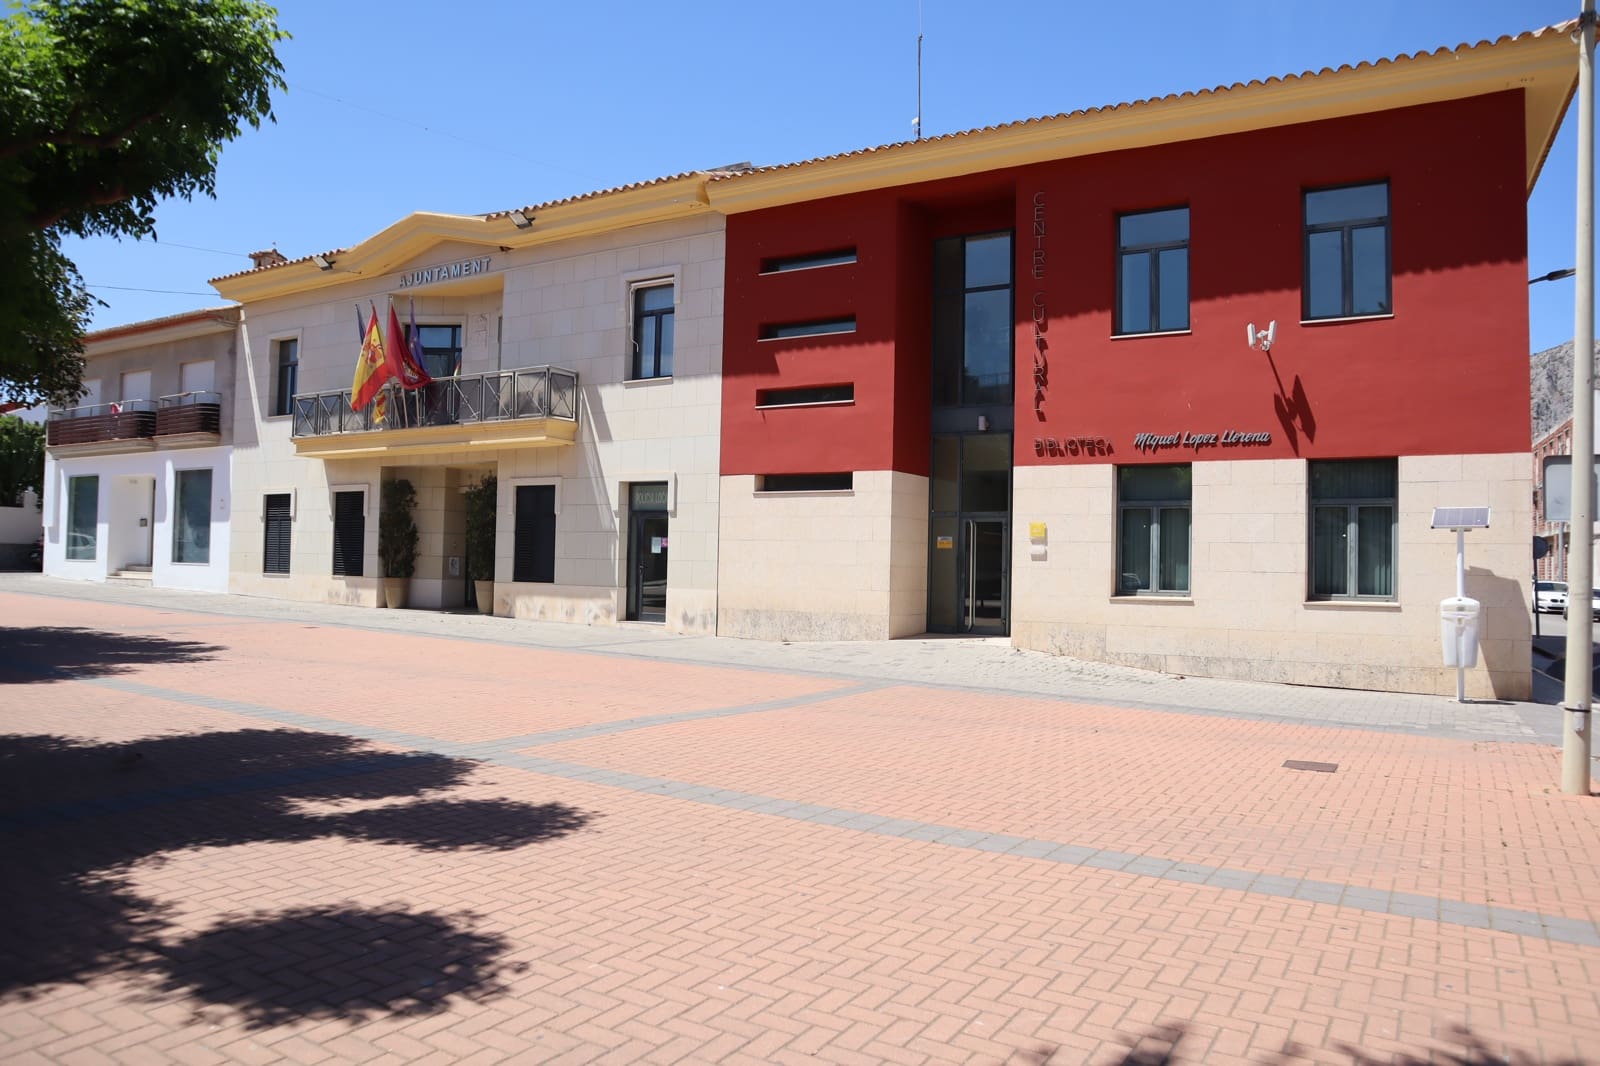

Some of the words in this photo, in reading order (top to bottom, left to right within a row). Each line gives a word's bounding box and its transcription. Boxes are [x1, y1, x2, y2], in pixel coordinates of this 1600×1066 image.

[1033, 191, 1046, 280] CENTRE
[400, 257, 491, 287] AJUNTAMENT
[1034, 436, 1113, 455] BIBLIOTECA
[1134, 432, 1180, 451] Miguel
[1183, 431, 1217, 449] Lopez
